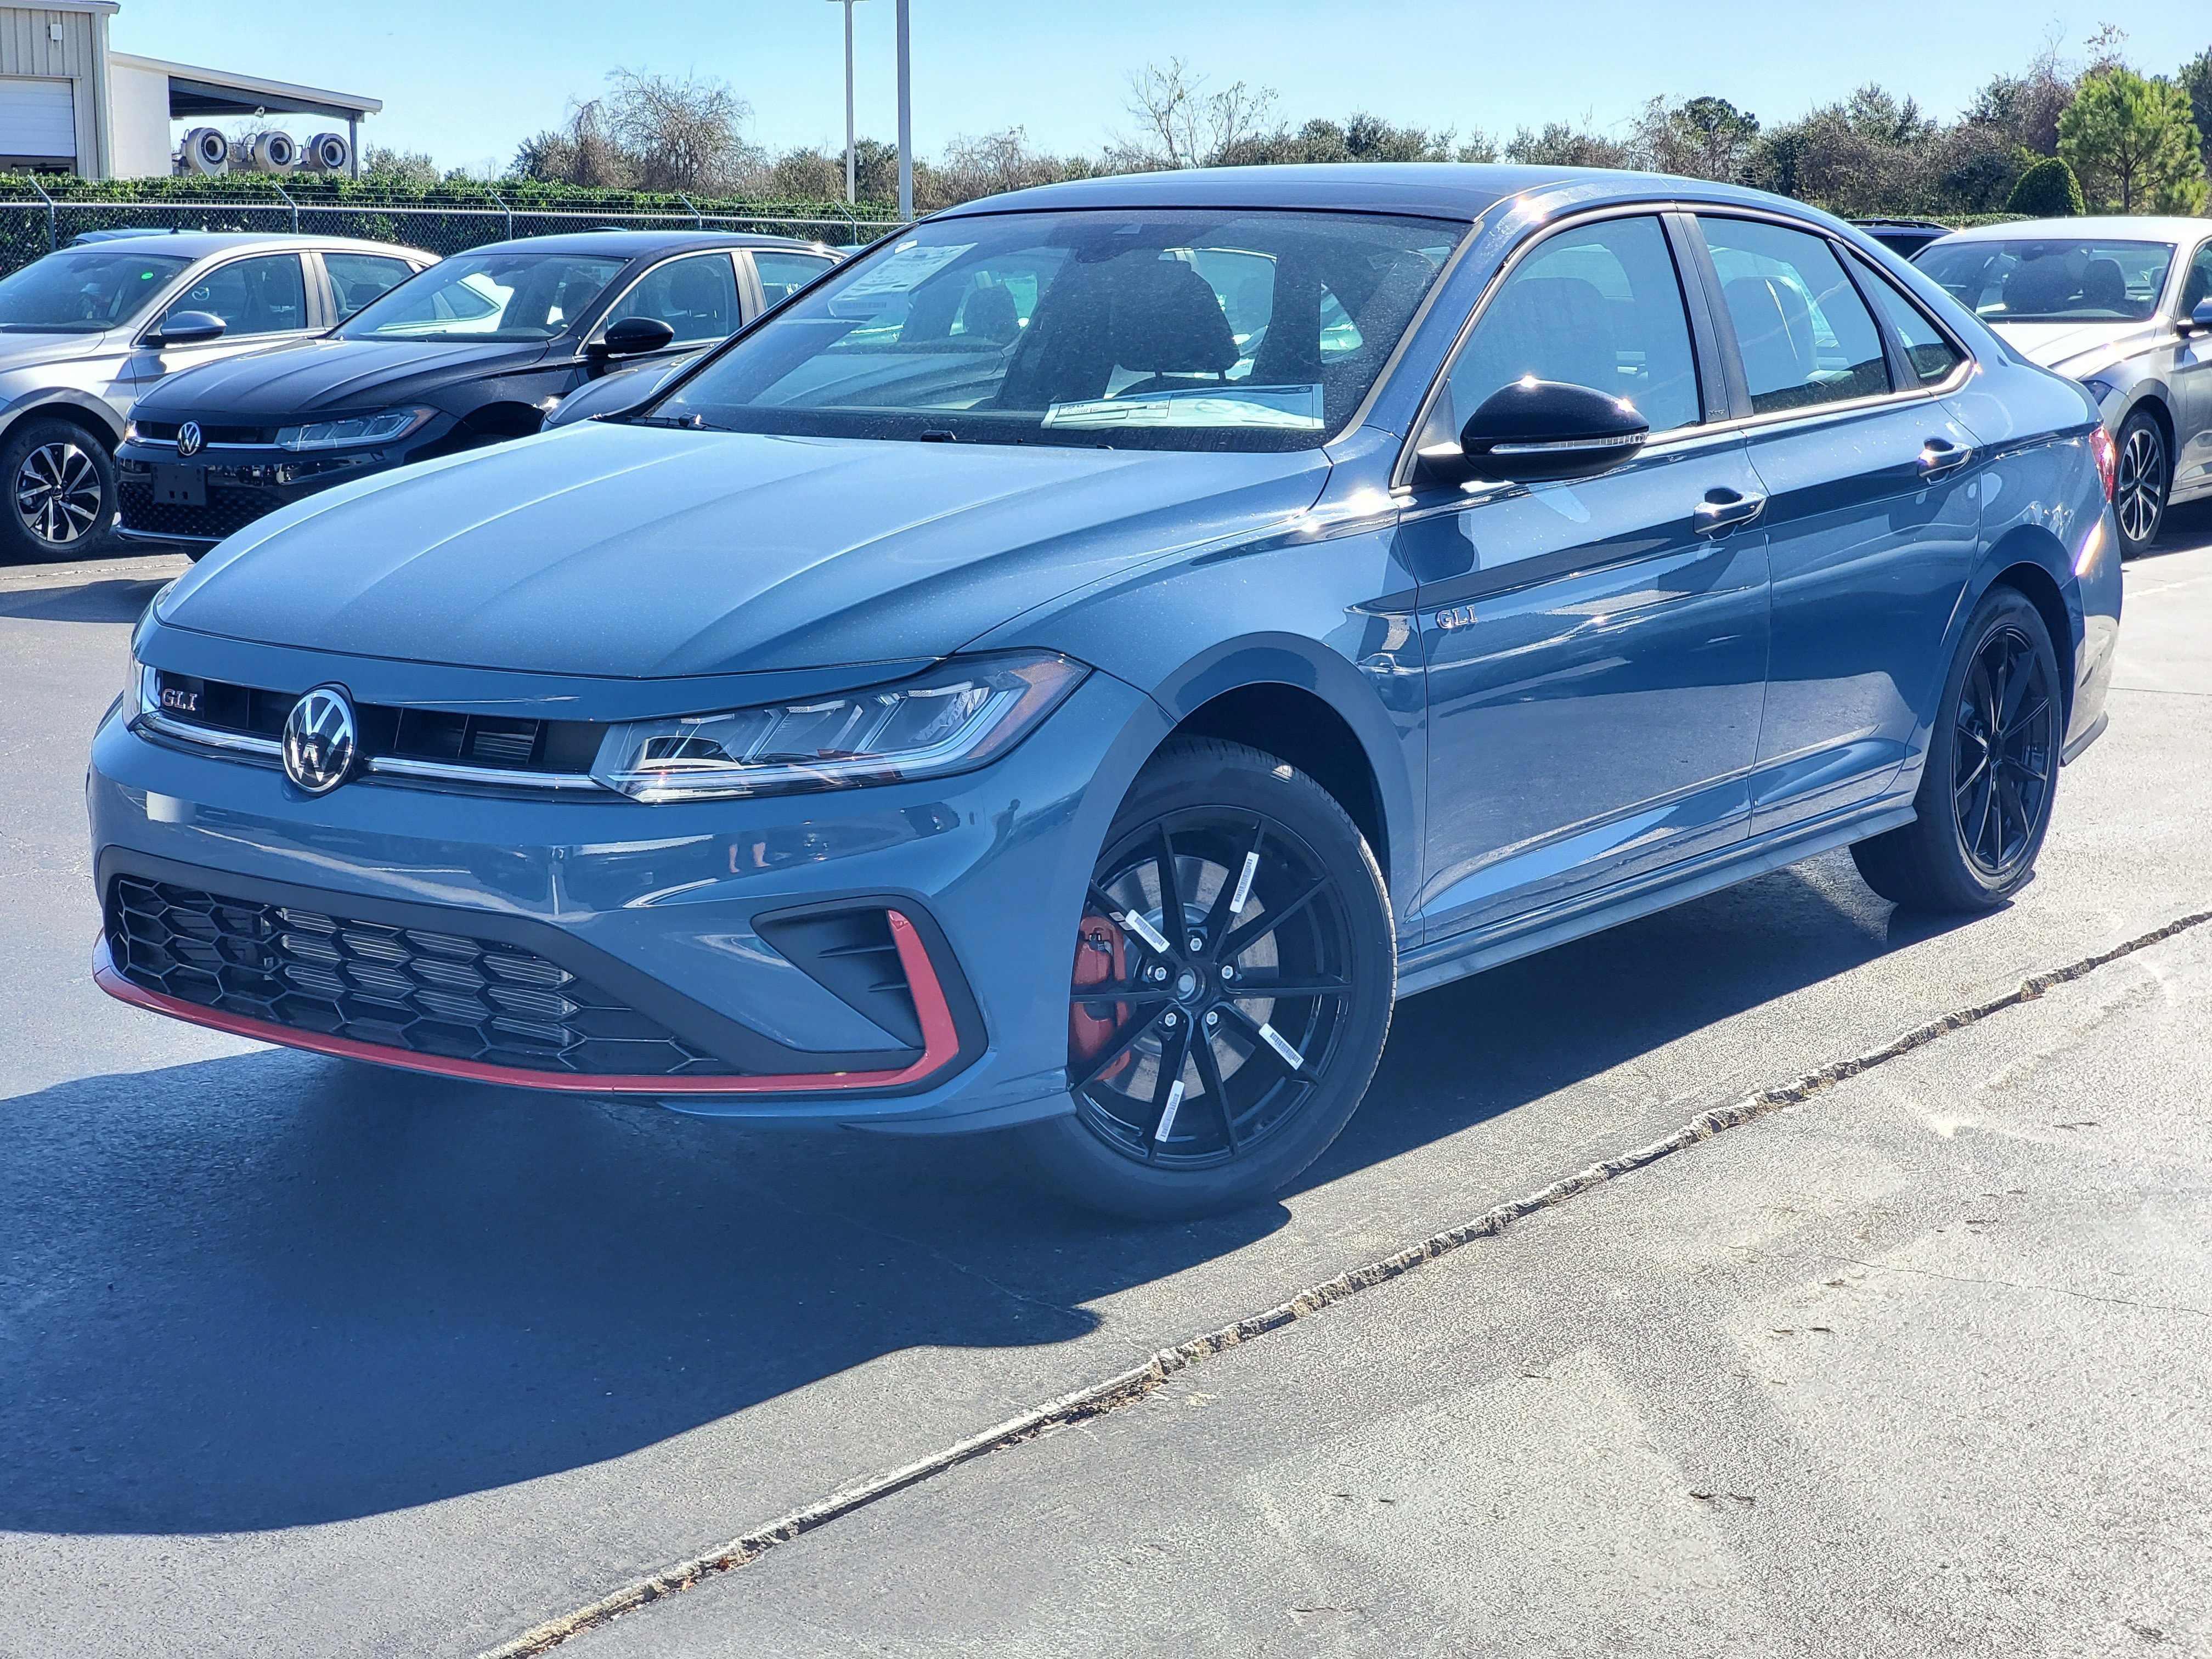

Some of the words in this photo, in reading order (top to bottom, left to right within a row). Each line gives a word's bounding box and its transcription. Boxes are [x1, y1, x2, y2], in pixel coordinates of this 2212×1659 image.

[1436, 605, 1479, 629] GLI
[162, 688, 198, 711] GLI
[284, 690, 353, 790] VW
